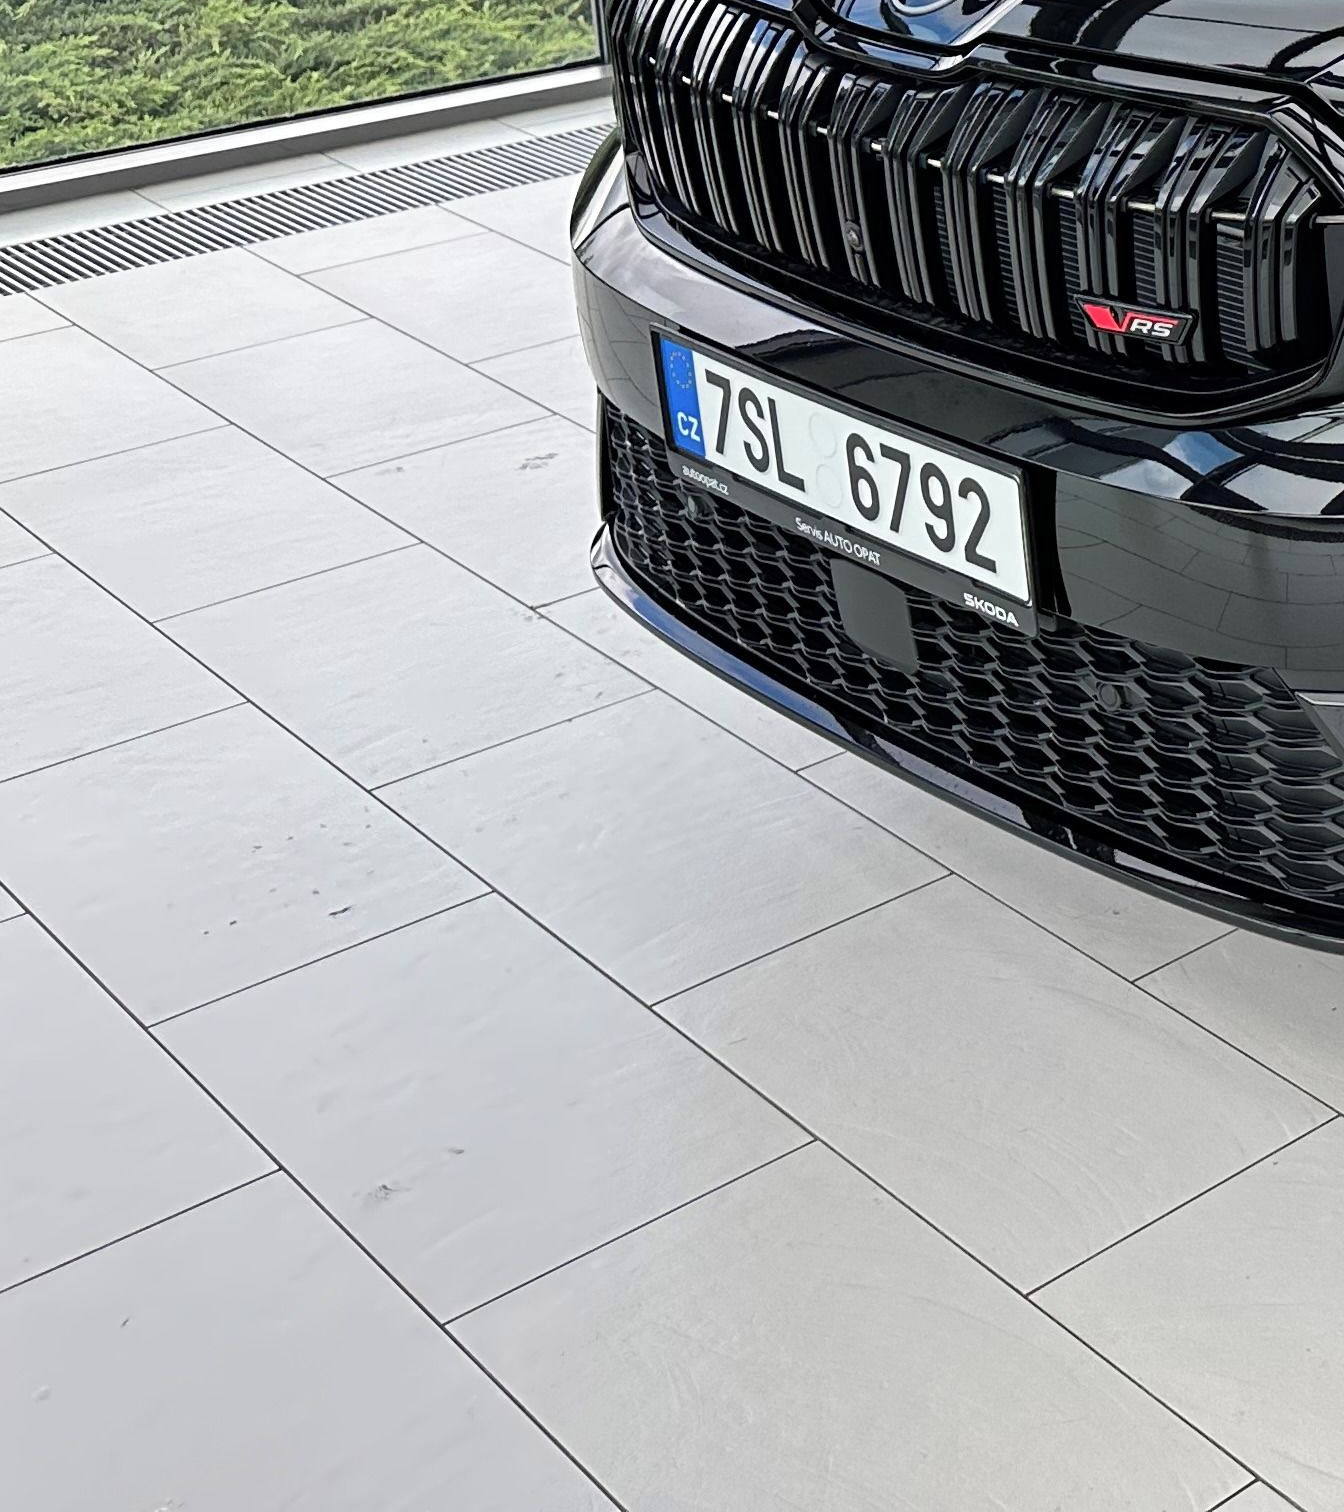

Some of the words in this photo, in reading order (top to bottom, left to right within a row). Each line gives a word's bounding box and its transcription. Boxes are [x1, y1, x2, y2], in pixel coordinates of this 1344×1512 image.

[676, 411, 701, 442] CZ
[704, 368, 806, 493] 7SL
[845, 432, 998, 575] 6792
[823, 529, 853, 554] AUTO
[853, 543, 881, 567] OPAT
